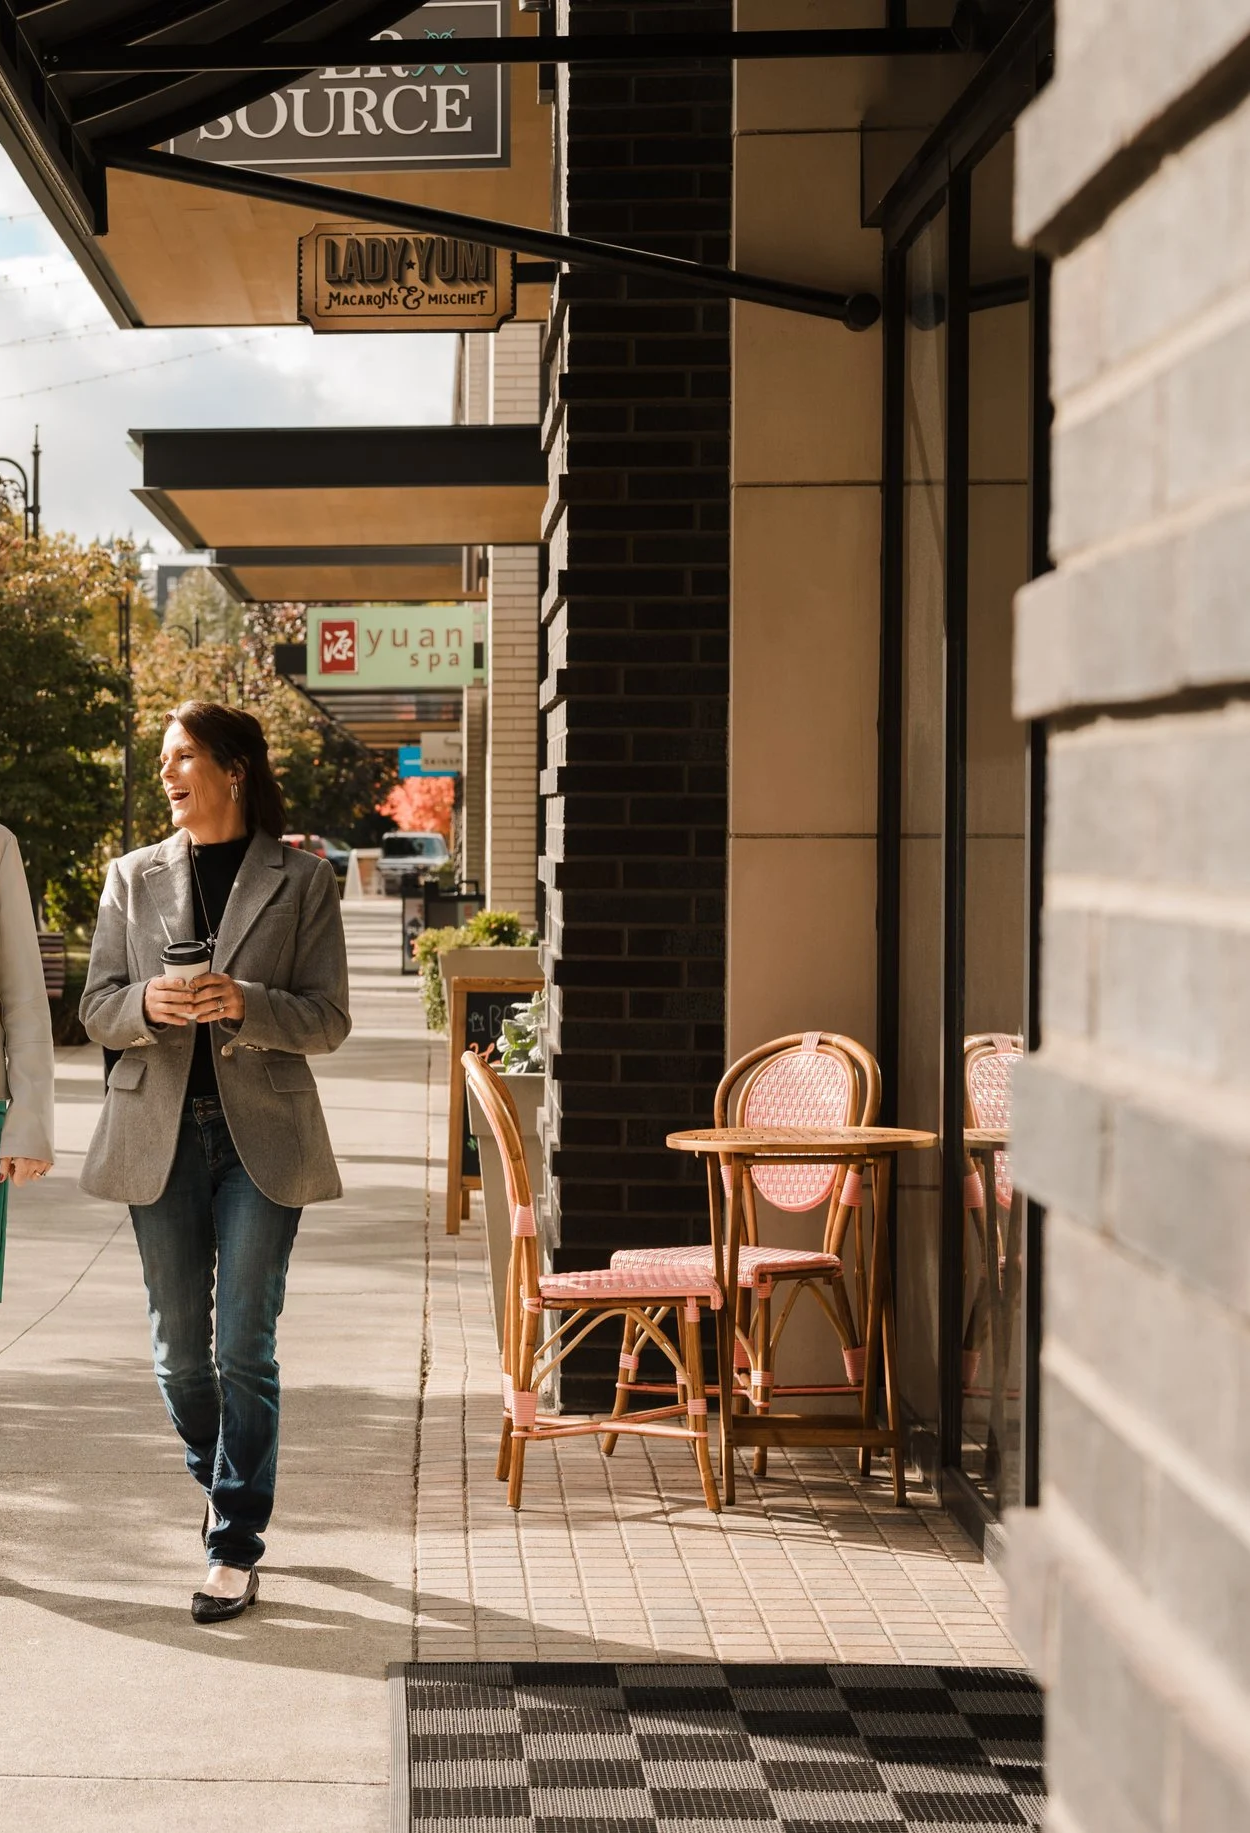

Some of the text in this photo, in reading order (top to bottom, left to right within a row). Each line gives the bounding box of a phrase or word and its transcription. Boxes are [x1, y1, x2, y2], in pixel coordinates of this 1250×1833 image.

[325, 237, 489, 284] LADY YUM
[397, 286, 425, 310] &
[428, 290, 488, 305] MISCHIEF
[323, 629, 354, 663] 源
[365, 627, 463, 658] yuan
[410, 652, 459, 673] spa
